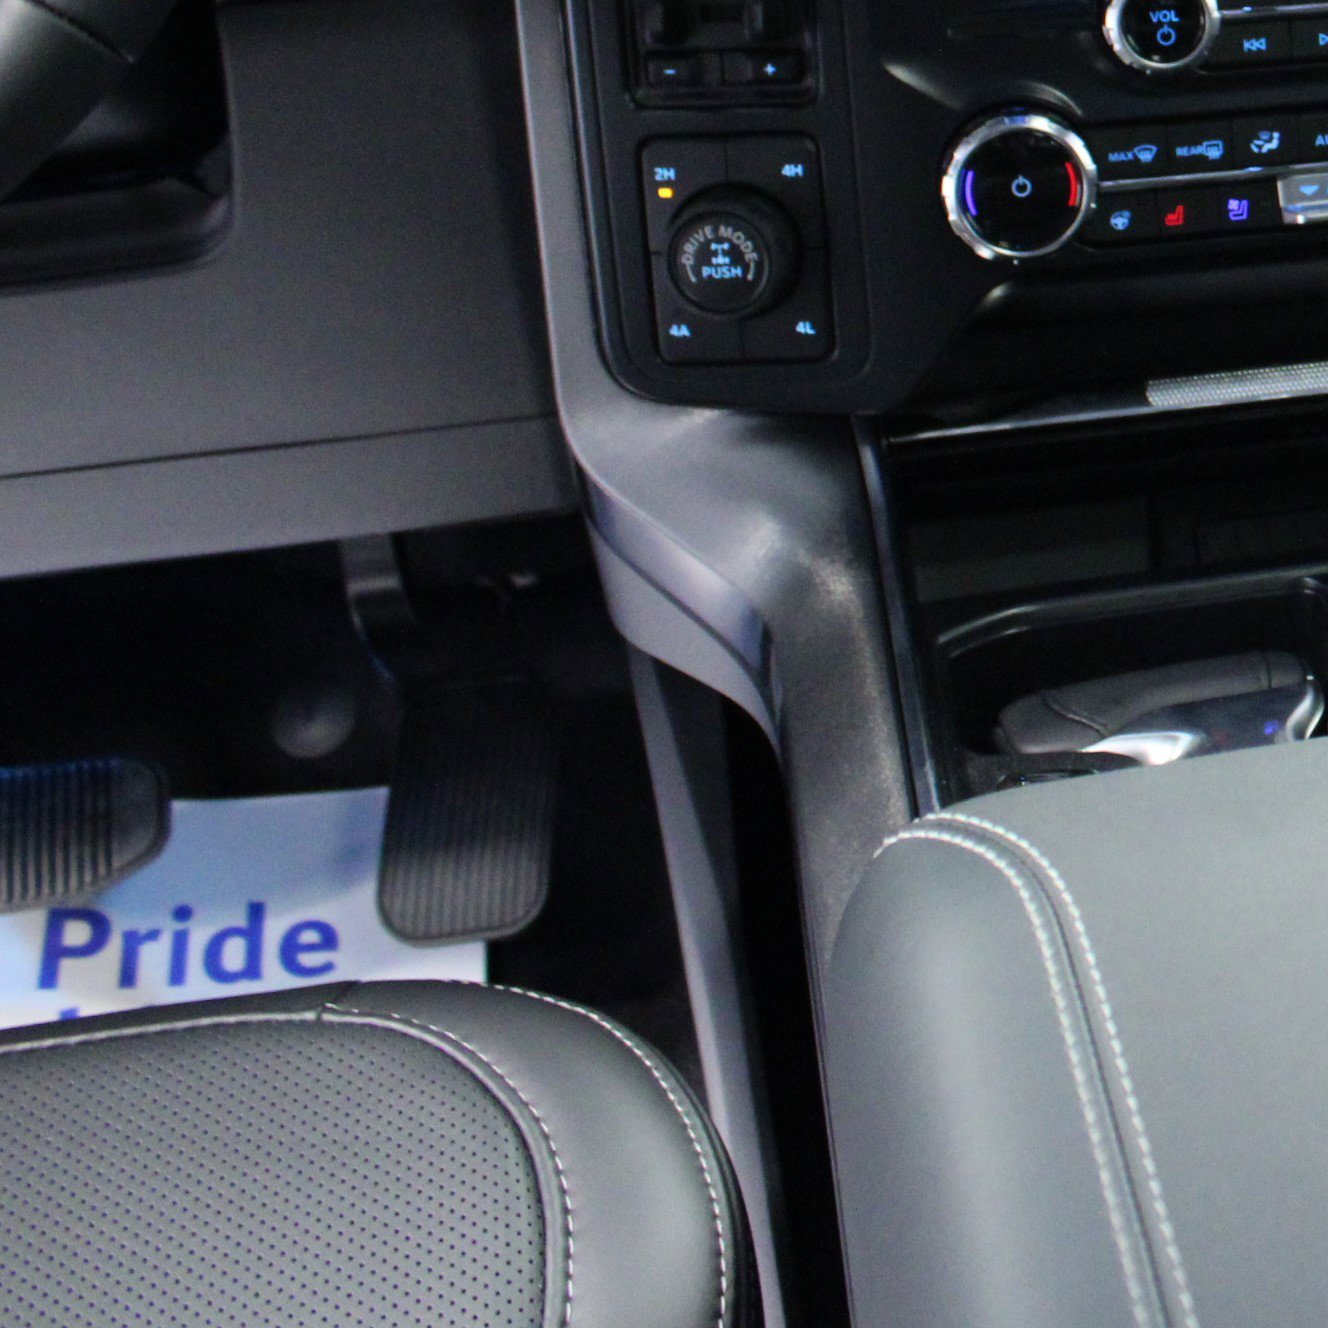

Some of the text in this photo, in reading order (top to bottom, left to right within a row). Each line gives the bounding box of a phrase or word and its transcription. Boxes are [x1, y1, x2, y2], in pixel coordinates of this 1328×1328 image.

[1148, 9, 1180, 23] VOL
[1107, 150, 1134, 163] MAX
[1175, 144, 1203, 157] REAR
[653, 166, 676, 181] 2H
[780, 163, 804, 177] 4H
[680, 224, 760, 266] DRIVE MODE
[701, 265, 742, 279] PUSH
[668, 323, 691, 338] 4A
[795, 320, 816, 335] 4L
[36, 900, 341, 991] Pride
